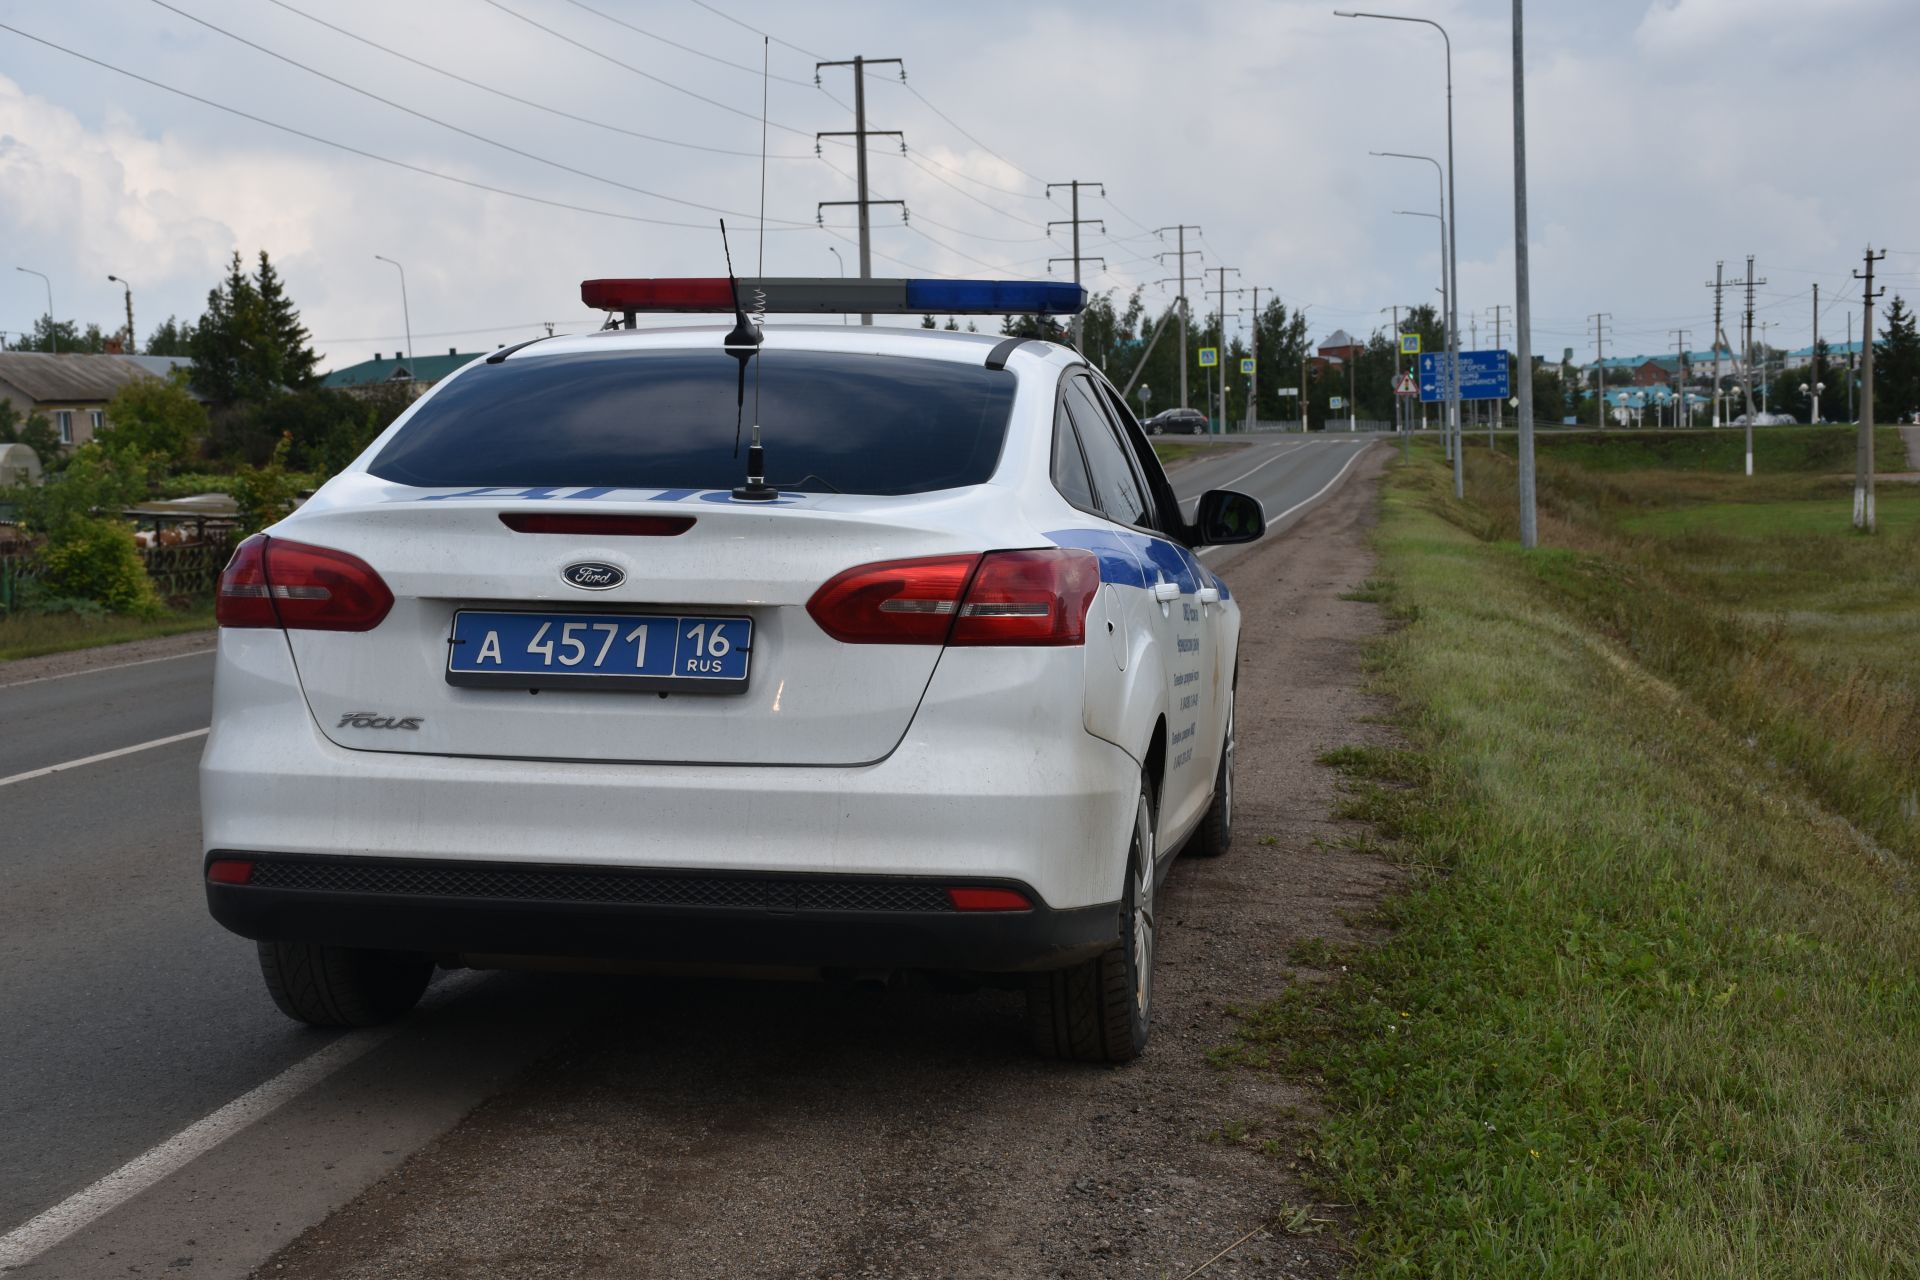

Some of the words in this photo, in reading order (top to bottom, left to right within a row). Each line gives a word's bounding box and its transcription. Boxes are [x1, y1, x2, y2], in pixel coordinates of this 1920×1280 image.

[575, 566, 612, 584] Ford
[476, 630, 502, 664] А
[527, 622, 648, 668] 4571
[686, 623, 730, 657] 16
[687, 659, 722, 673] RUS
